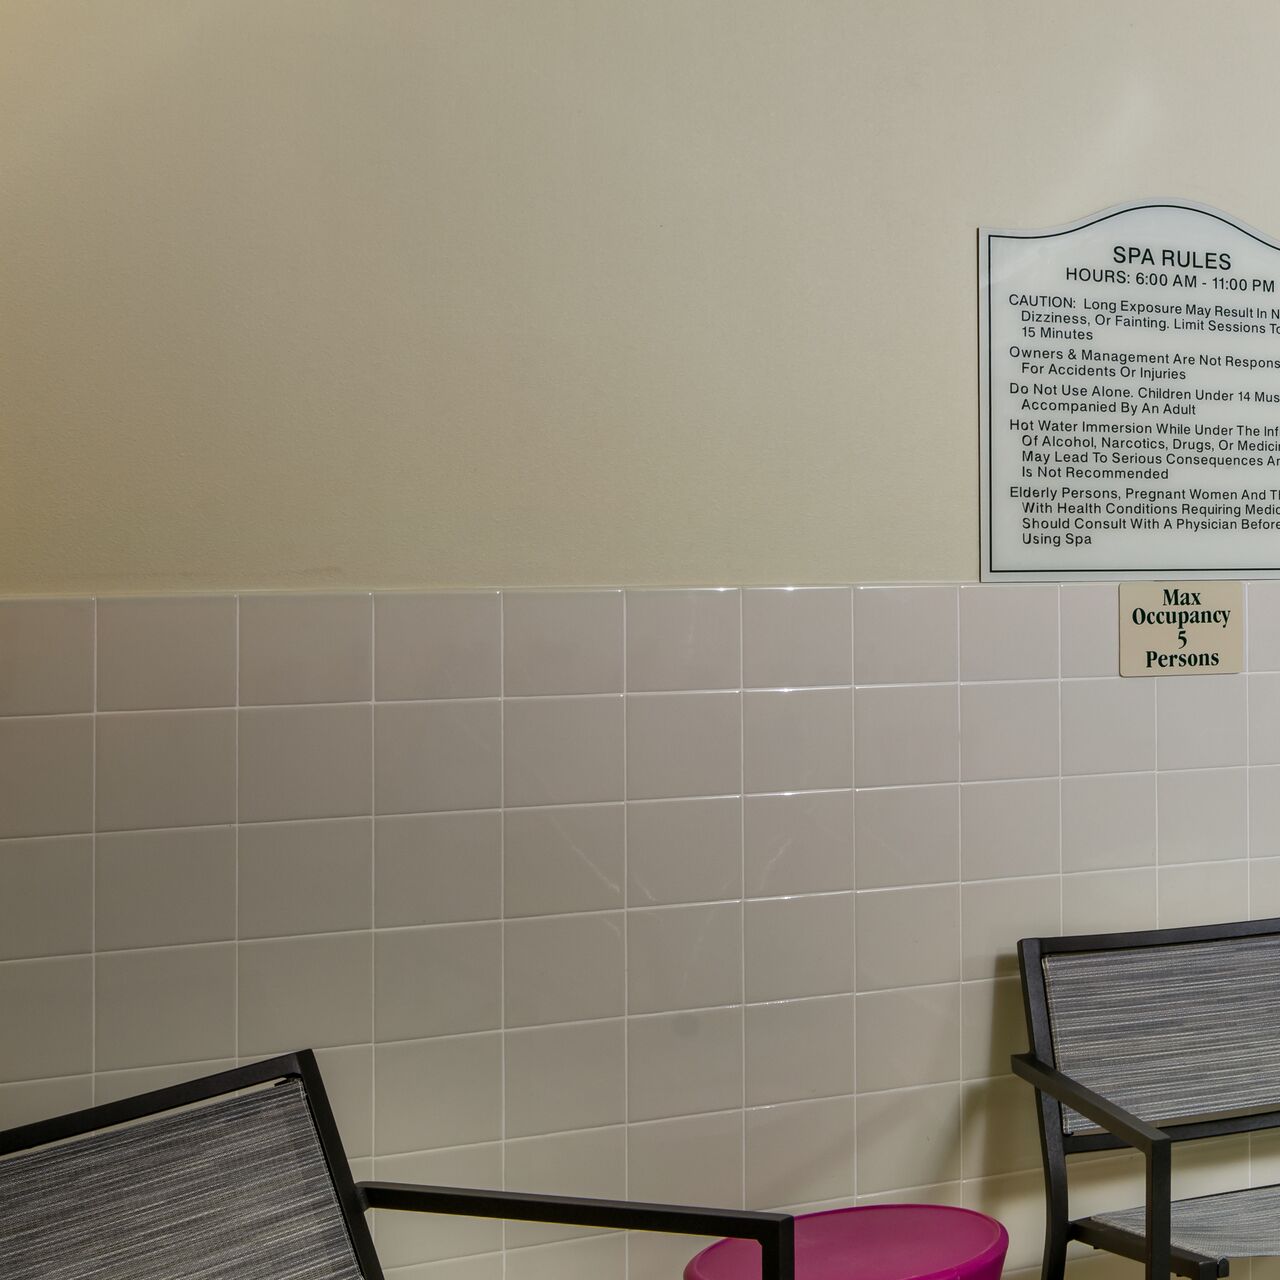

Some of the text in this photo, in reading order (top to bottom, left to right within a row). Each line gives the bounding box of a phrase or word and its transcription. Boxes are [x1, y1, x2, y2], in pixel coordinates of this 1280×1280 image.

[1113, 246, 1231, 271] SPA RULES
[1066, 267, 1130, 284] HOURS:
[1135, 272, 1168, 287] 6:00
[1172, 274, 1197, 288] AM
[1212, 277, 1248, 291] 11:00
[1252, 279, 1275, 293] PM
[1009, 294, 1076, 309] CAUTION:
[1084, 298, 1117, 314] Long
[1120, 300, 1182, 315] Exposure
[1185, 304, 1211, 319] May
[1214, 305, 1254, 318] Result
[1256, 308, 1267, 319] In
[1021, 310, 1090, 327] Dizziness,
[1095, 313, 1111, 326] Or
[1115, 315, 1170, 332] Fainting.
[1174, 318, 1204, 331] Limit
[1208, 319, 1266, 334] Sessions
[1022, 326, 1093, 341] 15 Minutes
[1009, 346, 1063, 360] Owners
[1067, 348, 1077, 360] &
[1081, 349, 1170, 365] Management
[1173, 353, 1195, 365] Are
[1199, 354, 1221, 366] Not
[1022, 362, 1186, 382] For Accidents Or Injuries
[1010, 382, 1029, 395] Do
[1033, 383, 1057, 396] Not
[1061, 384, 1088, 397] Use
[1091, 385, 1134, 398] Alone.
[1138, 387, 1191, 400] Children
[1195, 389, 1234, 401] Under
[1238, 391, 1251, 402] 14
[1021, 398, 1196, 416] Accompanied By An Adult
[1010, 419, 1034, 431] Hot
[1038, 419, 1078, 432] Water
[1082, 421, 1152, 434] Immersion
[1156, 423, 1191, 435] While
[1195, 424, 1234, 436] Under
[1236, 425, 1260, 437] The
[1022, 434, 1038, 447] Of
[1042, 435, 1097, 450] Alcohol,
[1101, 437, 1168, 451] Narcotics,
[1173, 438, 1214, 453] Drugs,
[1218, 439, 1234, 451] Or
[1022, 450, 1051, 465] May
[1055, 451, 1088, 463] Lead
[1092, 451, 1108, 463] To
[1112, 452, 1162, 465] Serious
[1166, 453, 1264, 468] Consequences
[1022, 466, 1168, 480] Is Not Recommended
[1010, 486, 1058, 501] Elderly
[1062, 487, 1121, 501] Persons,
[1126, 488, 1186, 502] Pregnant
[1189, 488, 1238, 500] Women
[1241, 489, 1266, 501] And
[1022, 501, 1053, 514] With
[1057, 502, 1101, 514] Health
[1105, 502, 1178, 515] Conditions
[1181, 503, 1241, 518] Requiring
[1022, 517, 1070, 530] Should
[1074, 517, 1127, 530] Consult
[1130, 518, 1160, 529] With
[1163, 518, 1173, 530] A
[1176, 518, 1237, 532] Physician
[1022, 532, 1092, 548] Using Spa
[1162, 588, 1202, 606] Max
[1132, 607, 1231, 630] Occupancy
[1178, 630, 1187, 649] 5
[1146, 650, 1220, 668] Persons
